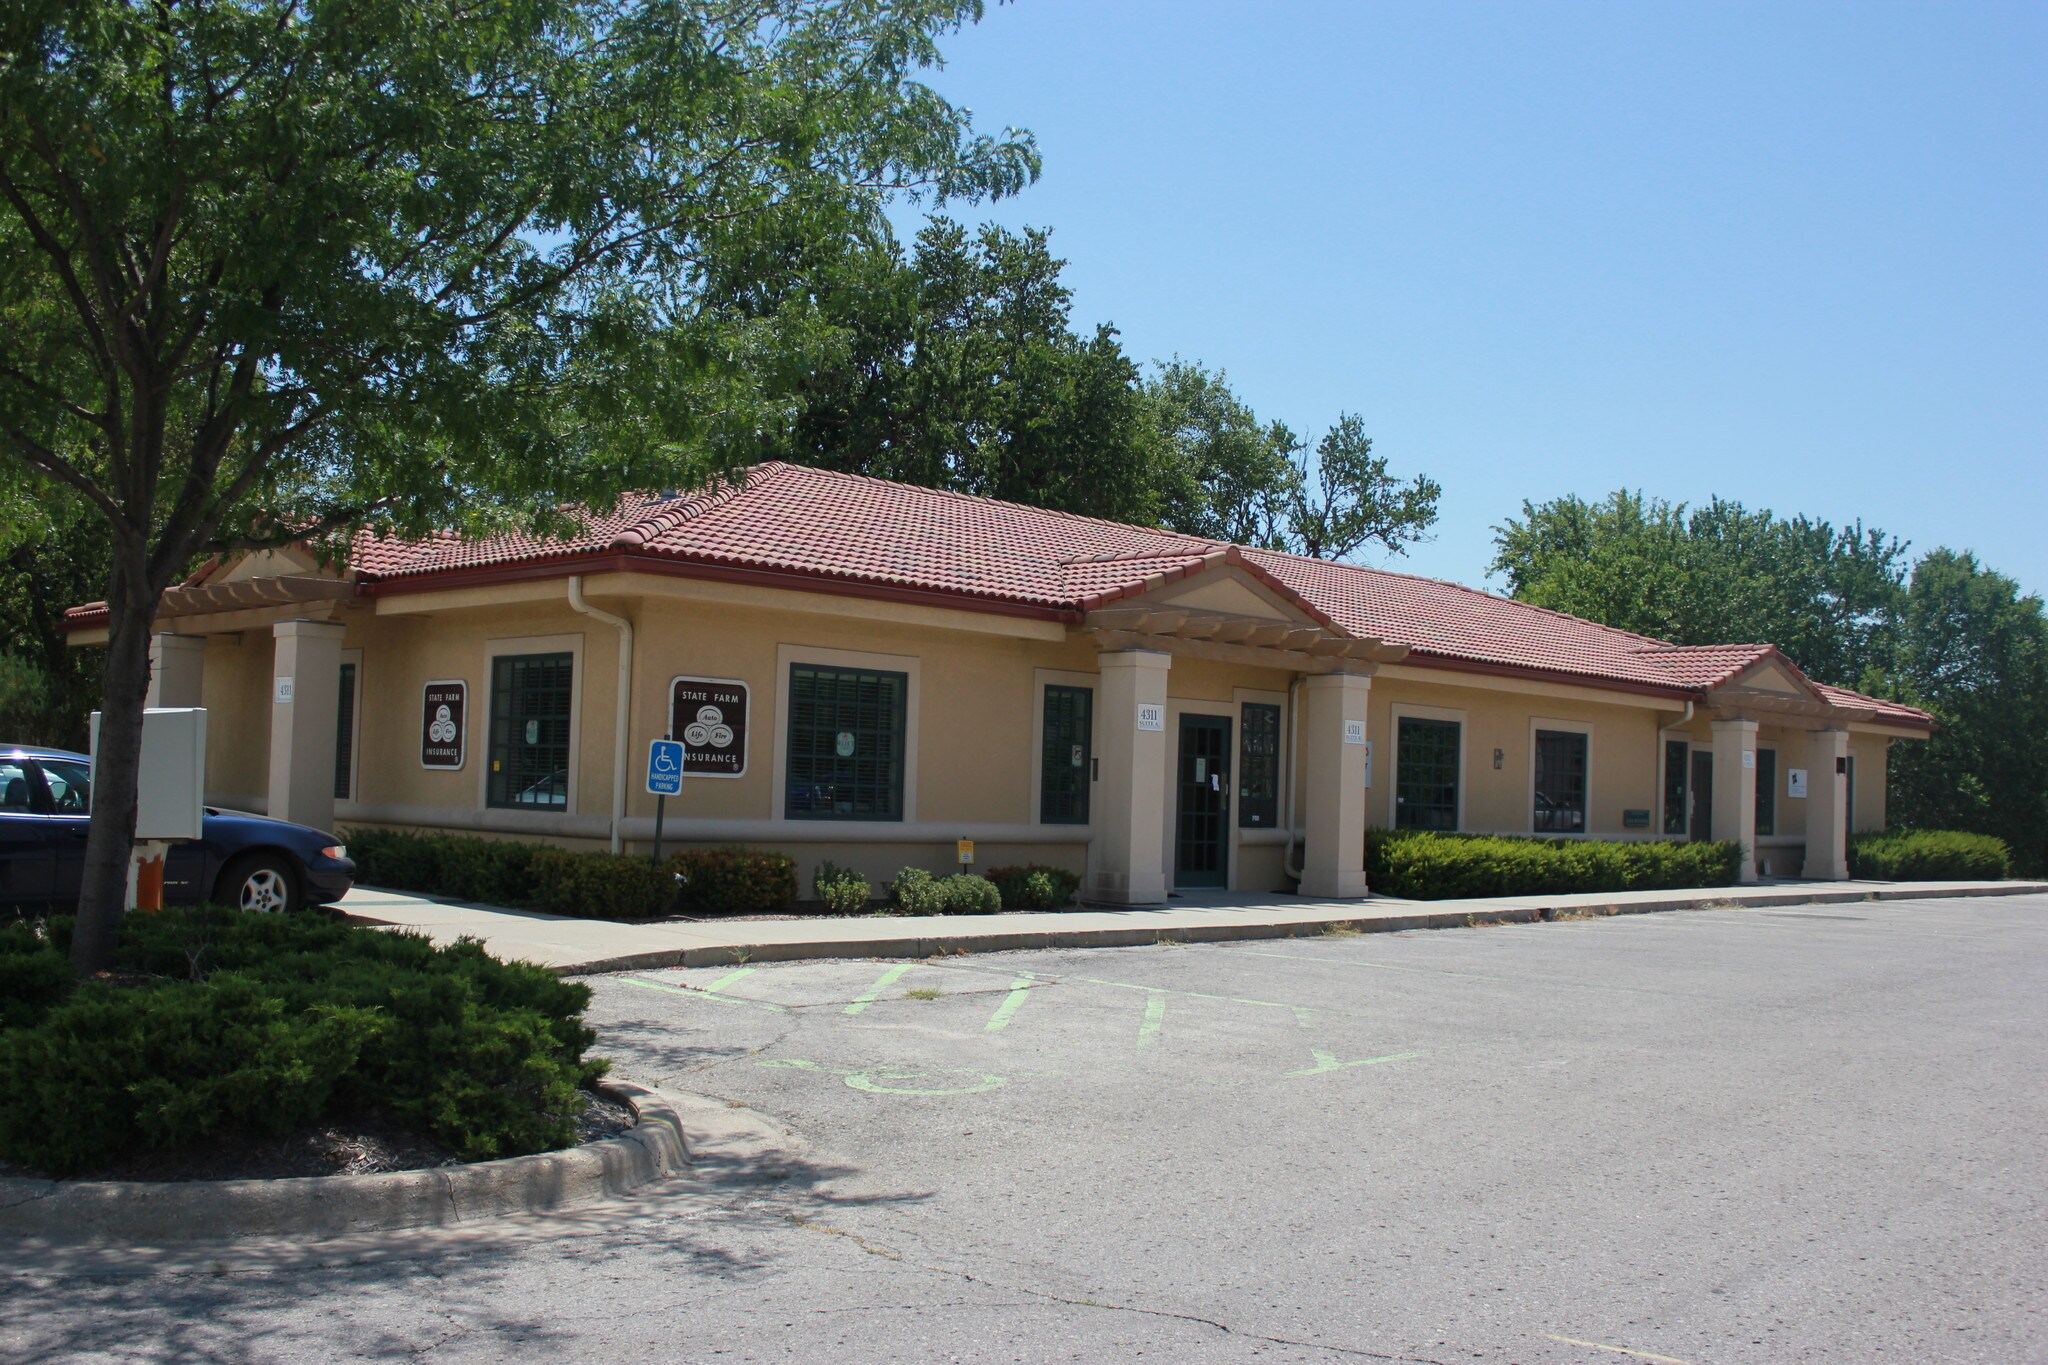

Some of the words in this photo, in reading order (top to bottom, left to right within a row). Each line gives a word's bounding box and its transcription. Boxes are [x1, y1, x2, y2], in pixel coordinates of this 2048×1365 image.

[428, 693, 443, 702] STATE
[445, 693, 460, 702] FARM
[682, 691, 707, 701] STATE
[714, 694, 739, 703] FARM
[701, 714, 718, 722] Auto
[1140, 709, 1157, 720] 4311
[1346, 725, 1360, 735] 4311
[691, 731, 703, 739] Life
[426, 748, 458, 756] INSURANCE
[684, 752, 737, 763] NSURANCE
[651, 773, 680, 782] HANDICAPPED
[655, 782, 673, 790] PARKING
